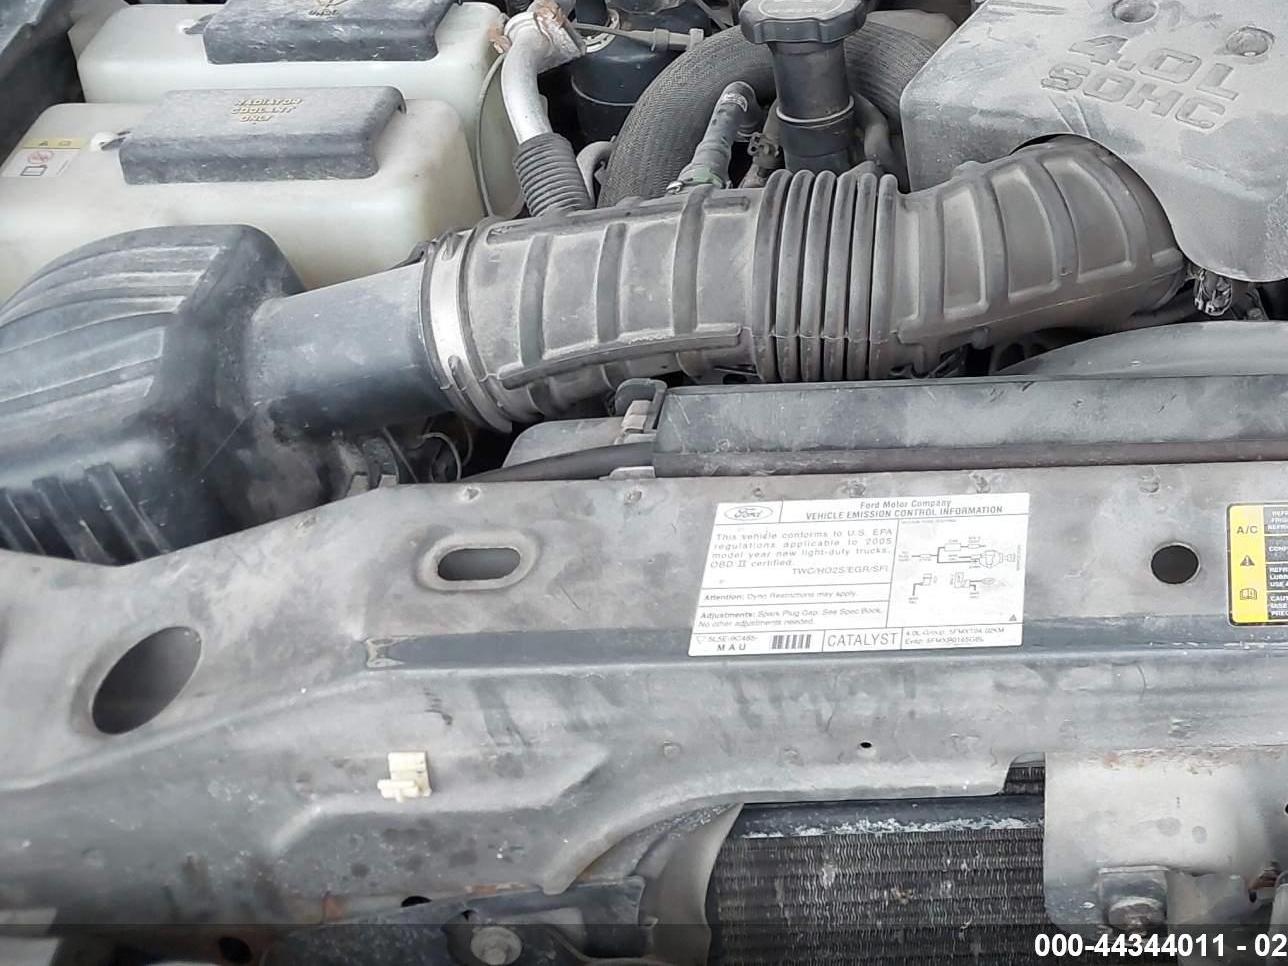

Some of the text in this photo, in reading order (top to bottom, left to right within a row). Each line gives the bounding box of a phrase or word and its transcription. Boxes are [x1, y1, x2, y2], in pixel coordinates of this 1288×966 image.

[1068, 35, 1239, 101] 4.0L
[1040, 63, 1226, 129] SOHC
[882, 501, 908, 509] Motor
[911, 500, 951, 509] Company
[734, 507, 763, 518] Ford
[806, 506, 1003, 520] VEHICLE EMISSION CONTROL INFORMATION
[717, 533, 737, 541] This
[782, 530, 828, 539] conforms
[872, 528, 893, 536] EPA
[1236, 525, 1258, 534] A/C
[783, 539, 840, 548] applicable
[866, 537, 893, 545] 2005
[748, 552, 771, 560] year
[802, 548, 850, 557] light-duty
[827, 633, 898, 647] CATALYST
